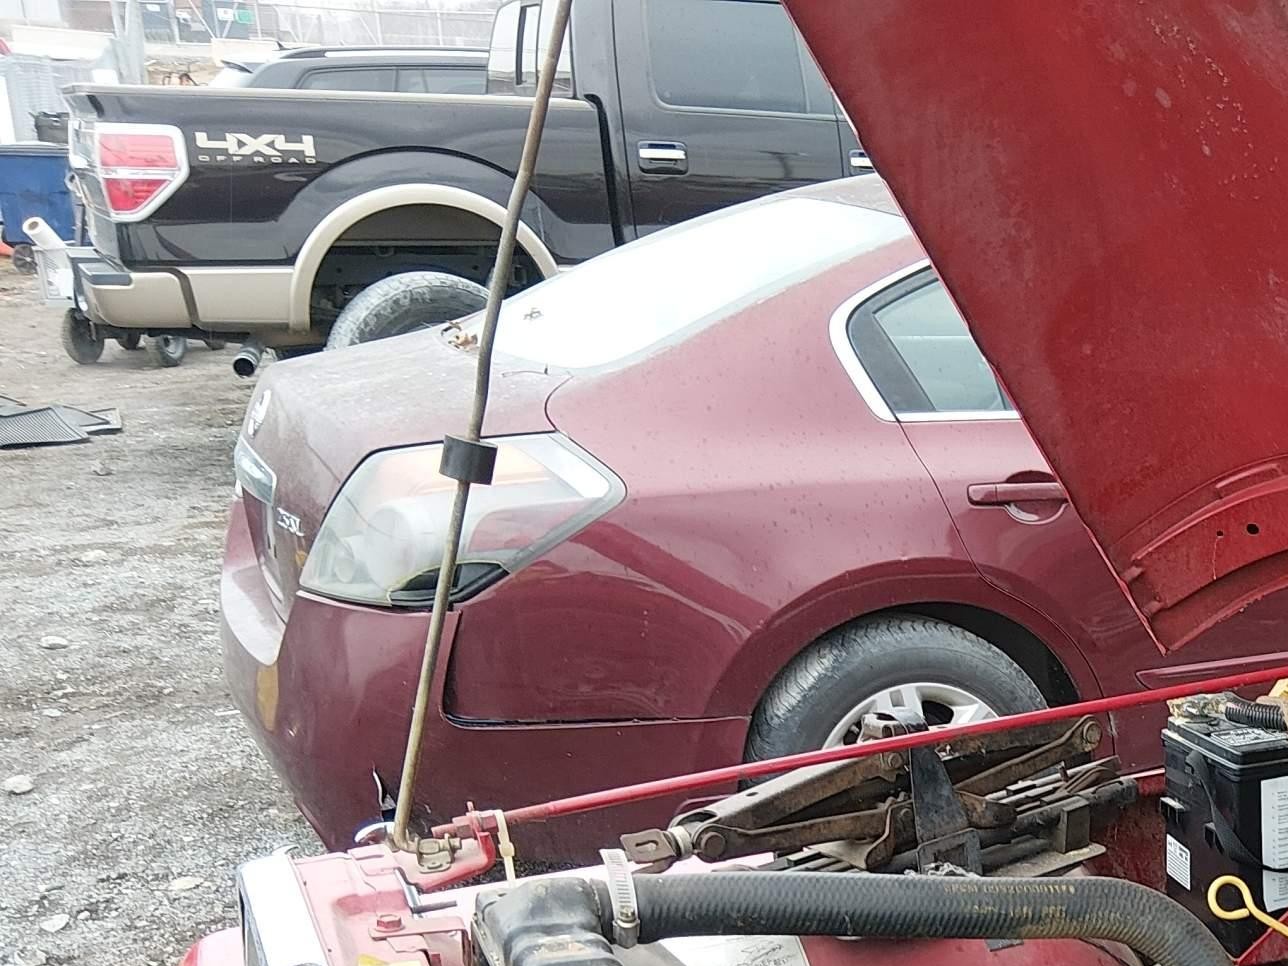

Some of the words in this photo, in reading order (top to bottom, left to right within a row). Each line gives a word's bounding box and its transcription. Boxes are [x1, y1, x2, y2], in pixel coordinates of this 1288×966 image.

[195, 131, 316, 157] 4X4
[198, 155, 243, 163] OFF
[254, 156, 317, 164] ROAD
